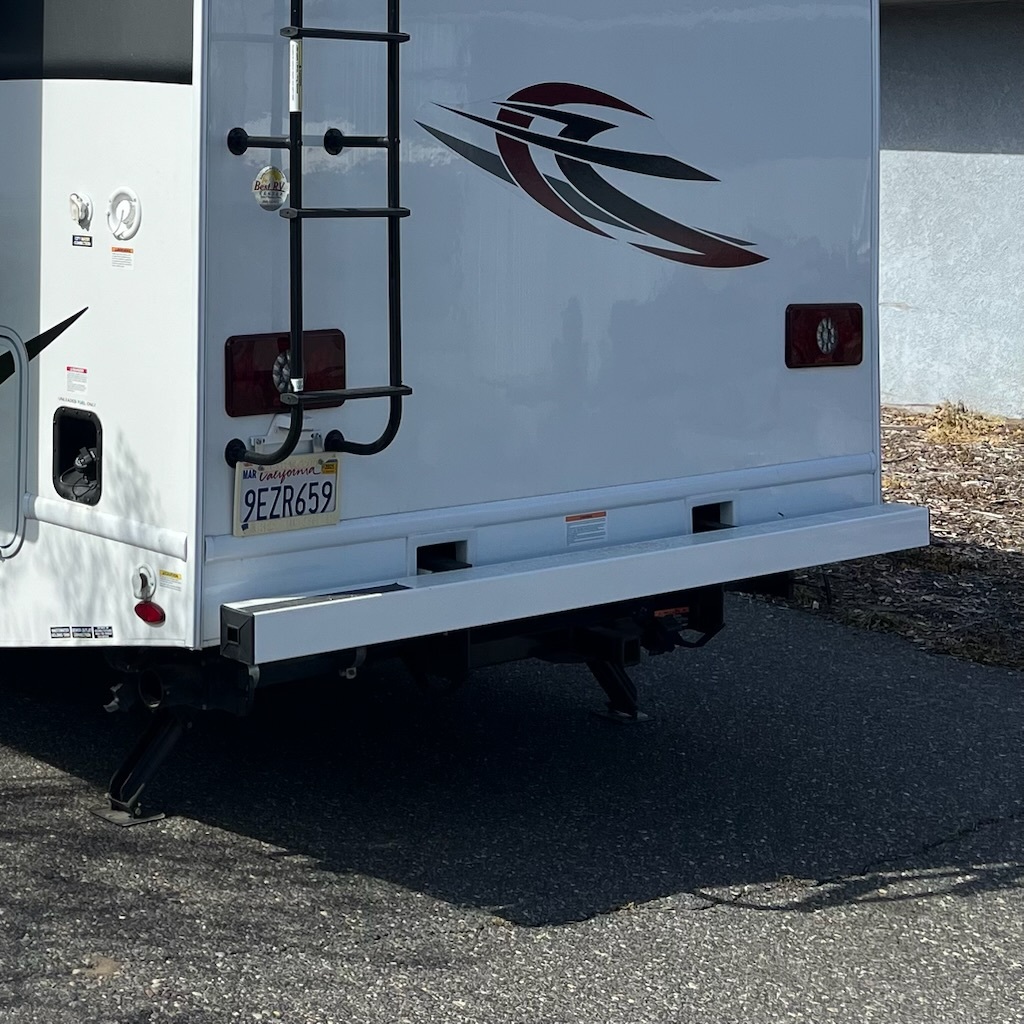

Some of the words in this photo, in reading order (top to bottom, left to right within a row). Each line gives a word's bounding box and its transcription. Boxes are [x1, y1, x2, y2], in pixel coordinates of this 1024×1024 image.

[272, 181, 286, 192] RV
[242, 469, 257, 480] MAR
[259, 466, 321, 485] California
[243, 480, 333, 523] 9EZR659
